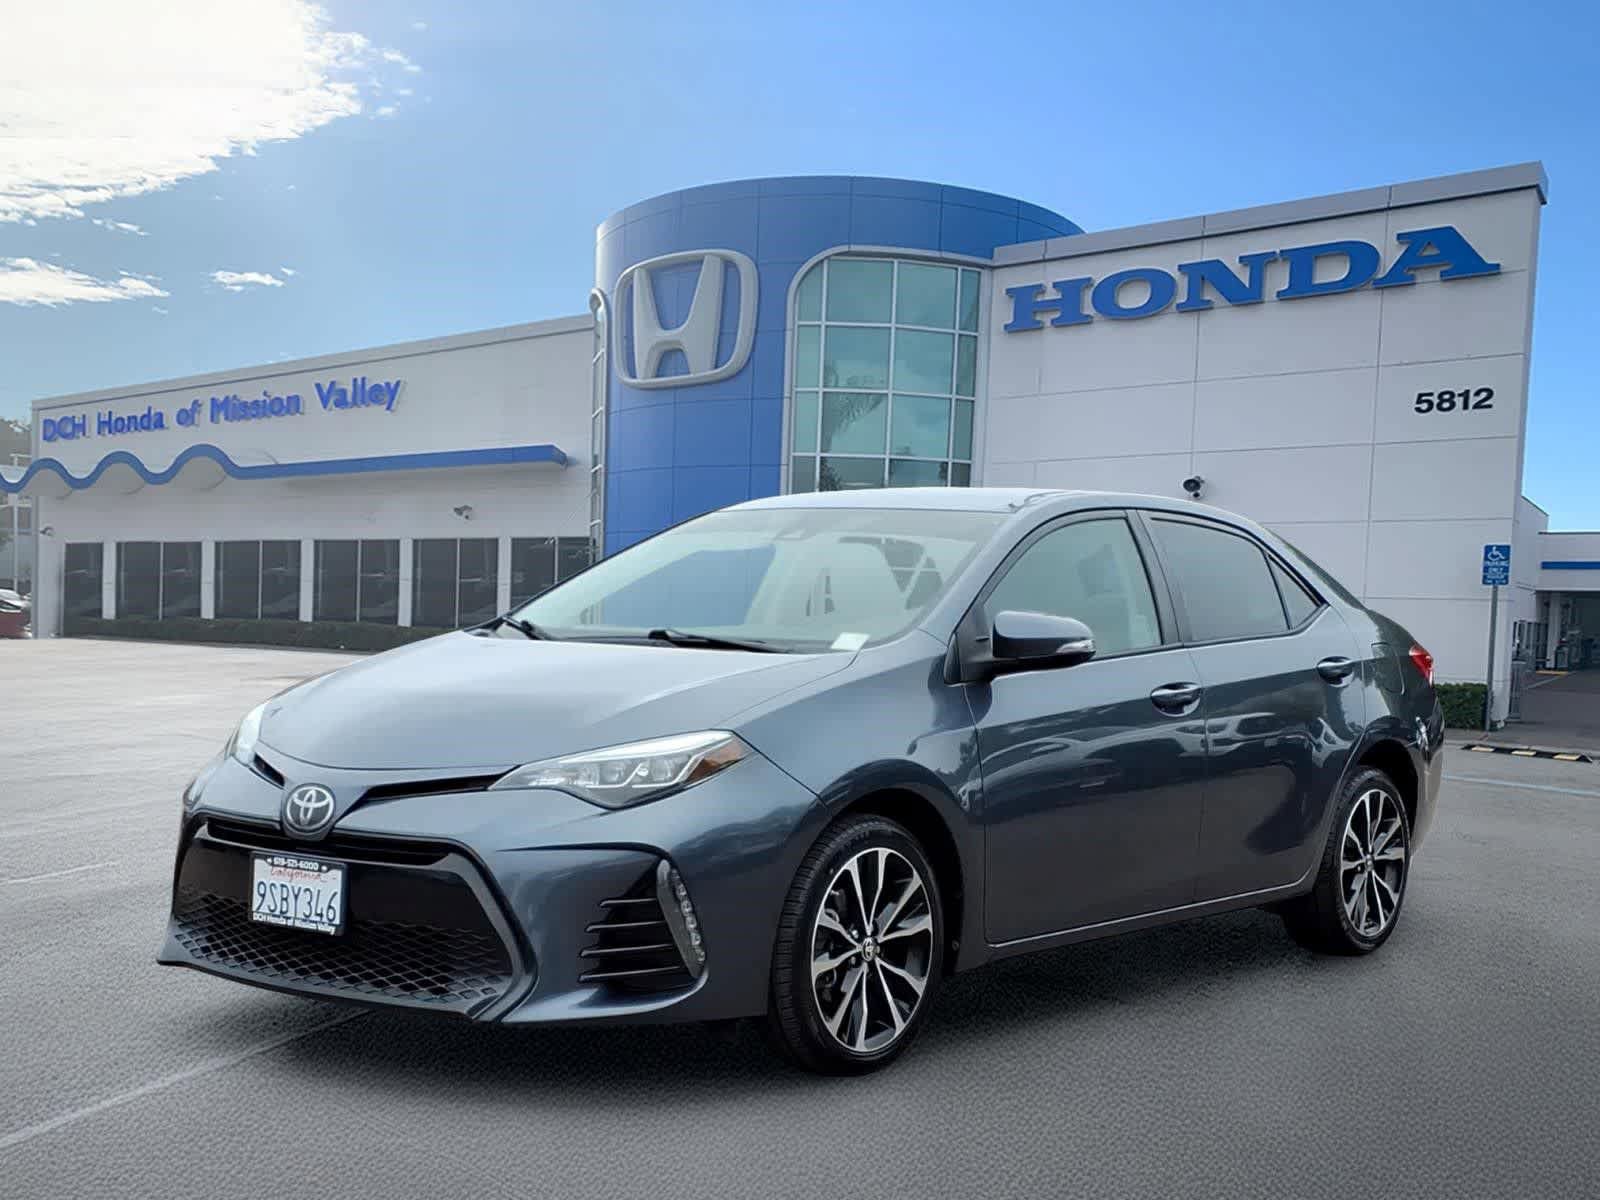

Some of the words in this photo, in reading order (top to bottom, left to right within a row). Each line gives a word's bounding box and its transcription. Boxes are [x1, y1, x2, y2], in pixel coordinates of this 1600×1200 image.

[1003, 225, 1501, 333] HONDA
[42, 414, 87, 442] DCH
[96, 405, 166, 436] Honda
[175, 399, 203, 427] of
[210, 390, 303, 424] Mission
[314, 376, 401, 412] Valley
[1414, 387, 1494, 414] 5812
[256, 881, 338, 922] 9SBY346
